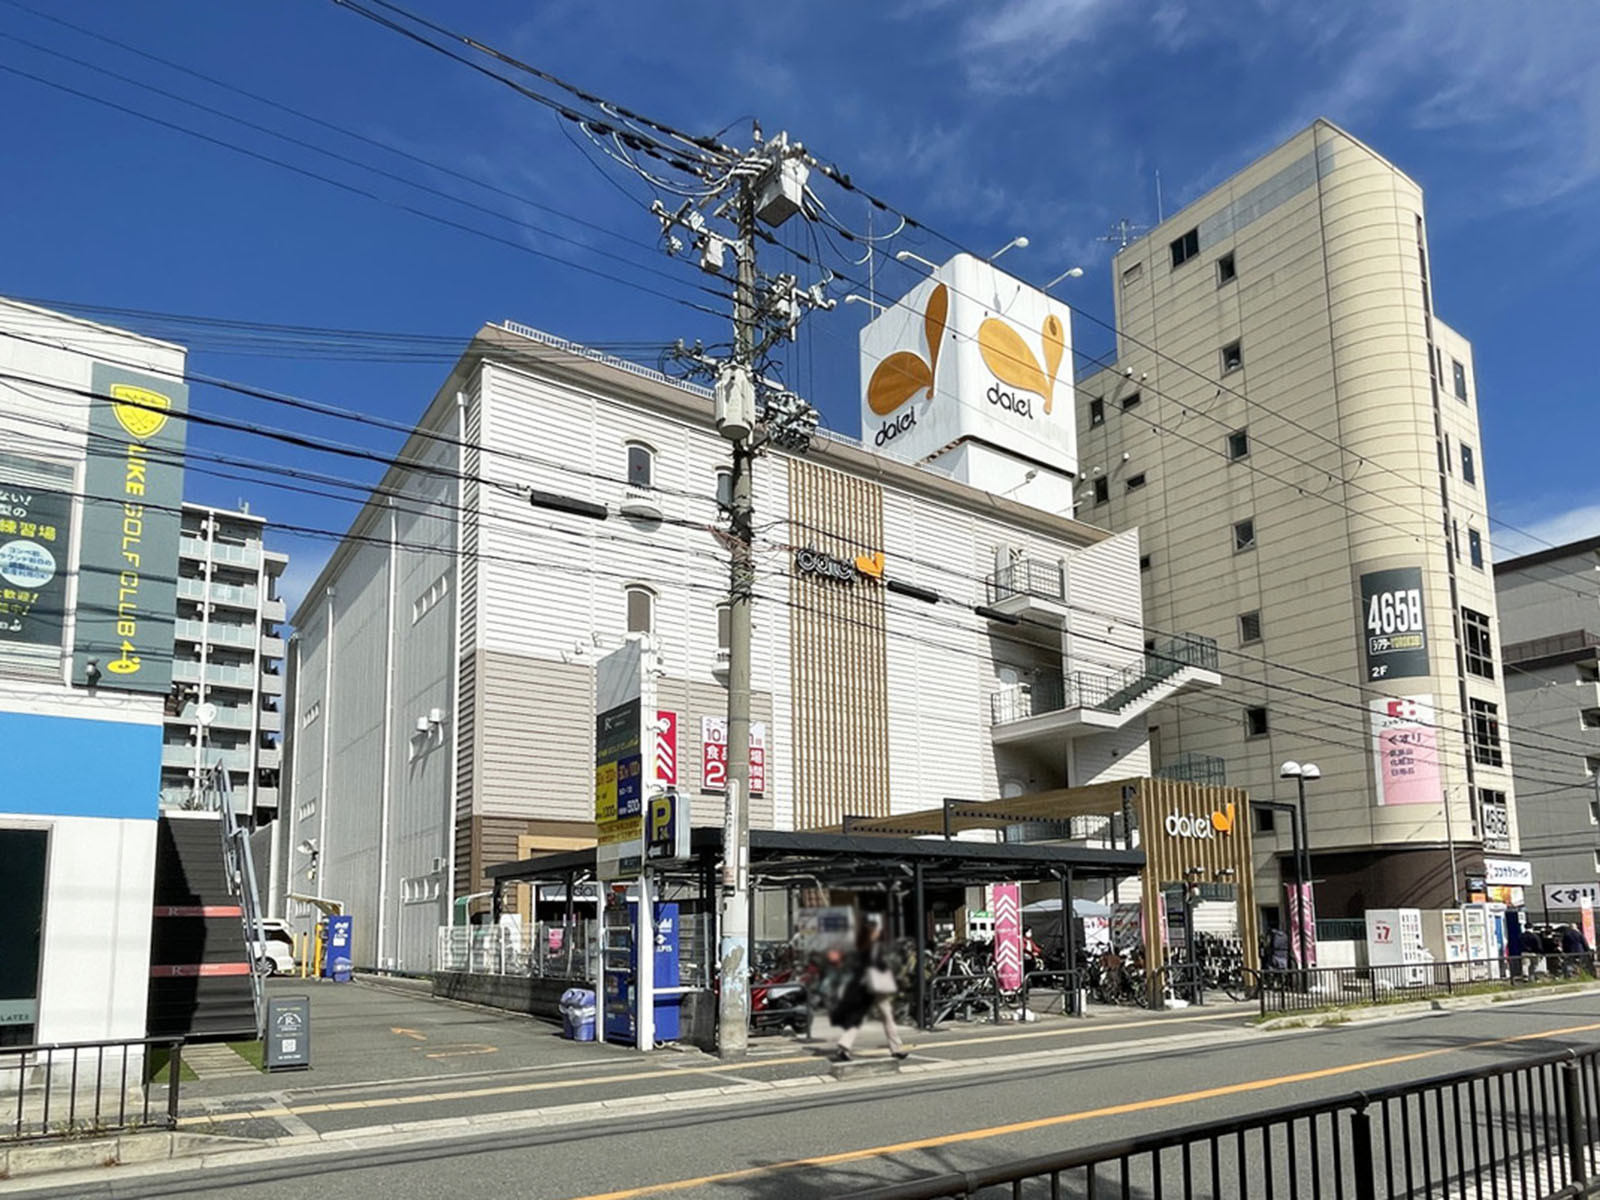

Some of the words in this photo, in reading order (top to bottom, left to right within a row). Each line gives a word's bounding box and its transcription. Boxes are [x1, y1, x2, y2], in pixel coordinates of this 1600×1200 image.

[986, 383, 1033, 420] daiei
[874, 406, 918, 447] daiei
[117, 571, 139, 637] CLUB
[1371, 665, 1389, 677] 2F
[1387, 732, 1422, 746] くすり
[652, 798, 671, 841] P
[1165, 807, 1214, 839] daiei
[1550, 887, 1597, 904] くすり
